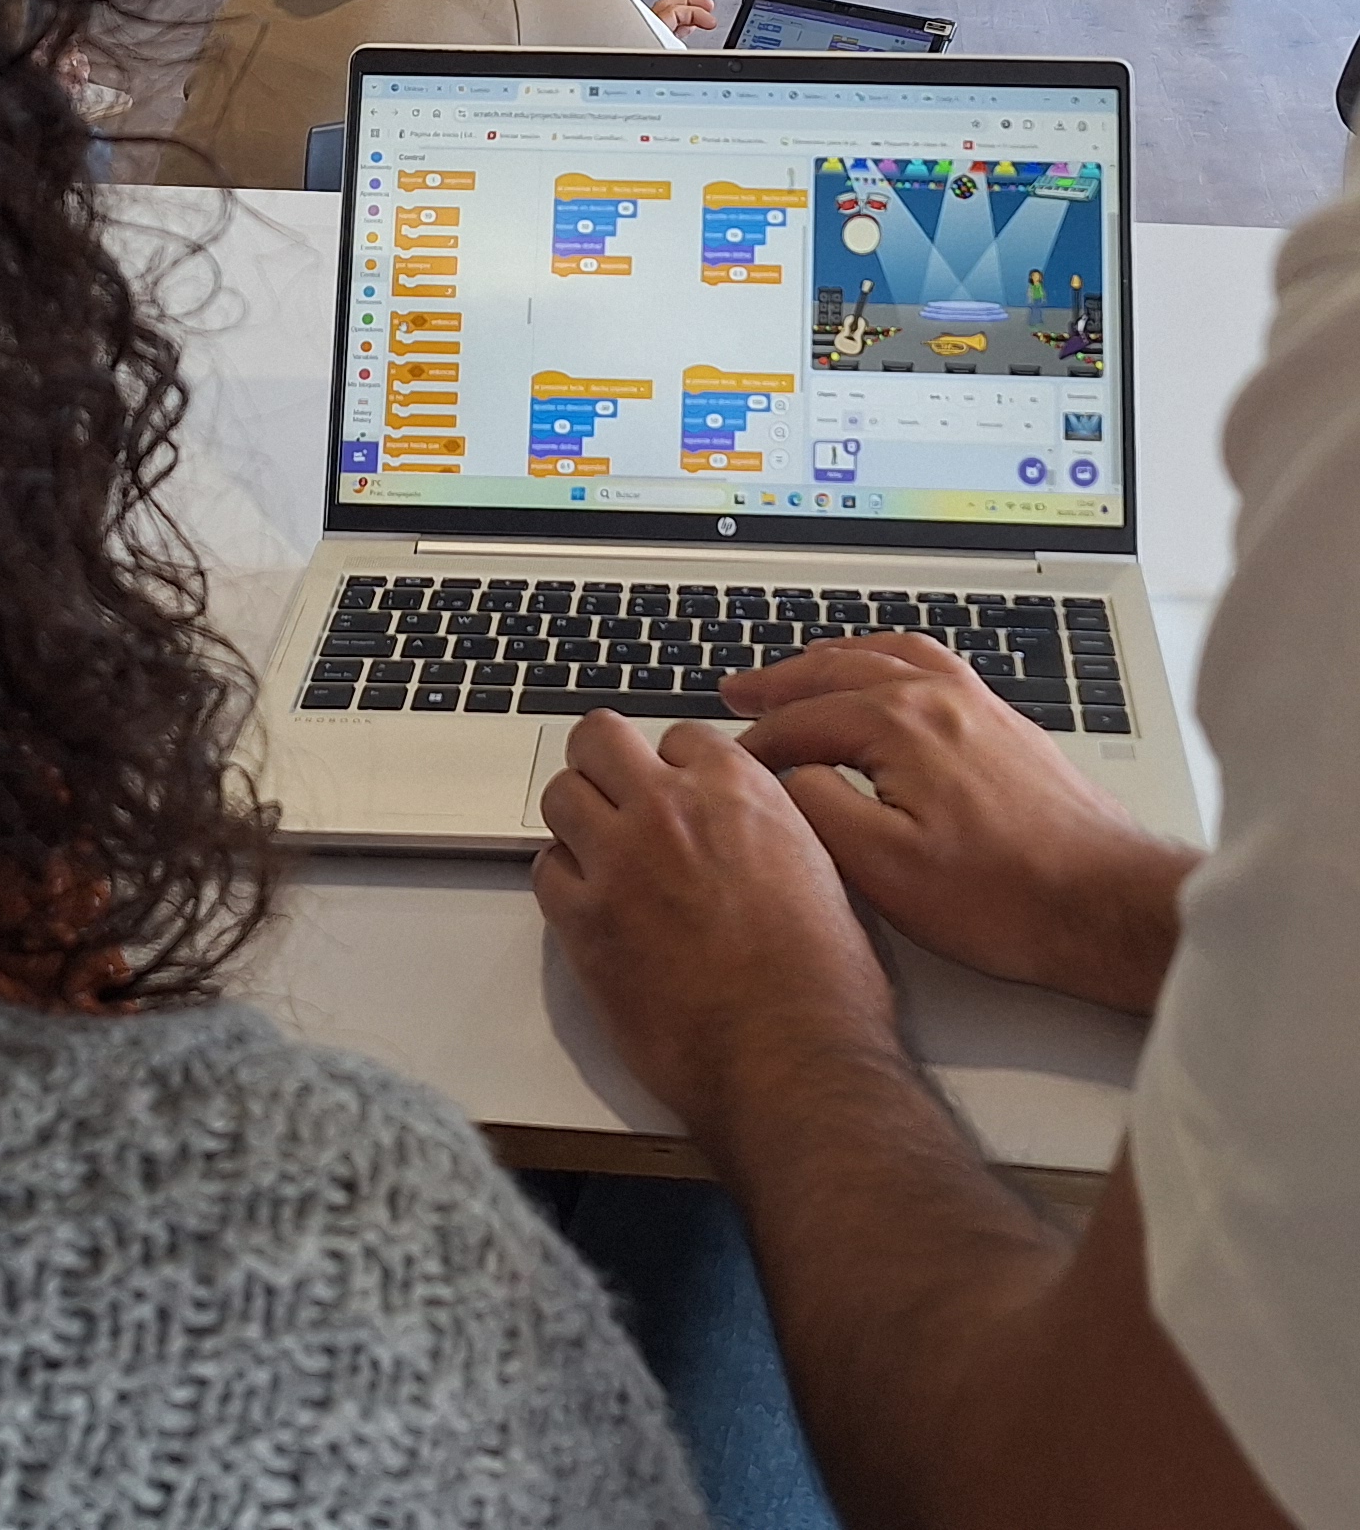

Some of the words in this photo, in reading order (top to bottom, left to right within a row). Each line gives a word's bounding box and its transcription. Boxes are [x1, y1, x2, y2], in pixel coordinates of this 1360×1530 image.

[399, 153, 426, 162] Control
[719, 516, 736, 536] hp
[457, 616, 472, 624] W
[809, 626, 823, 635] O
[690, 671, 703, 680] N
